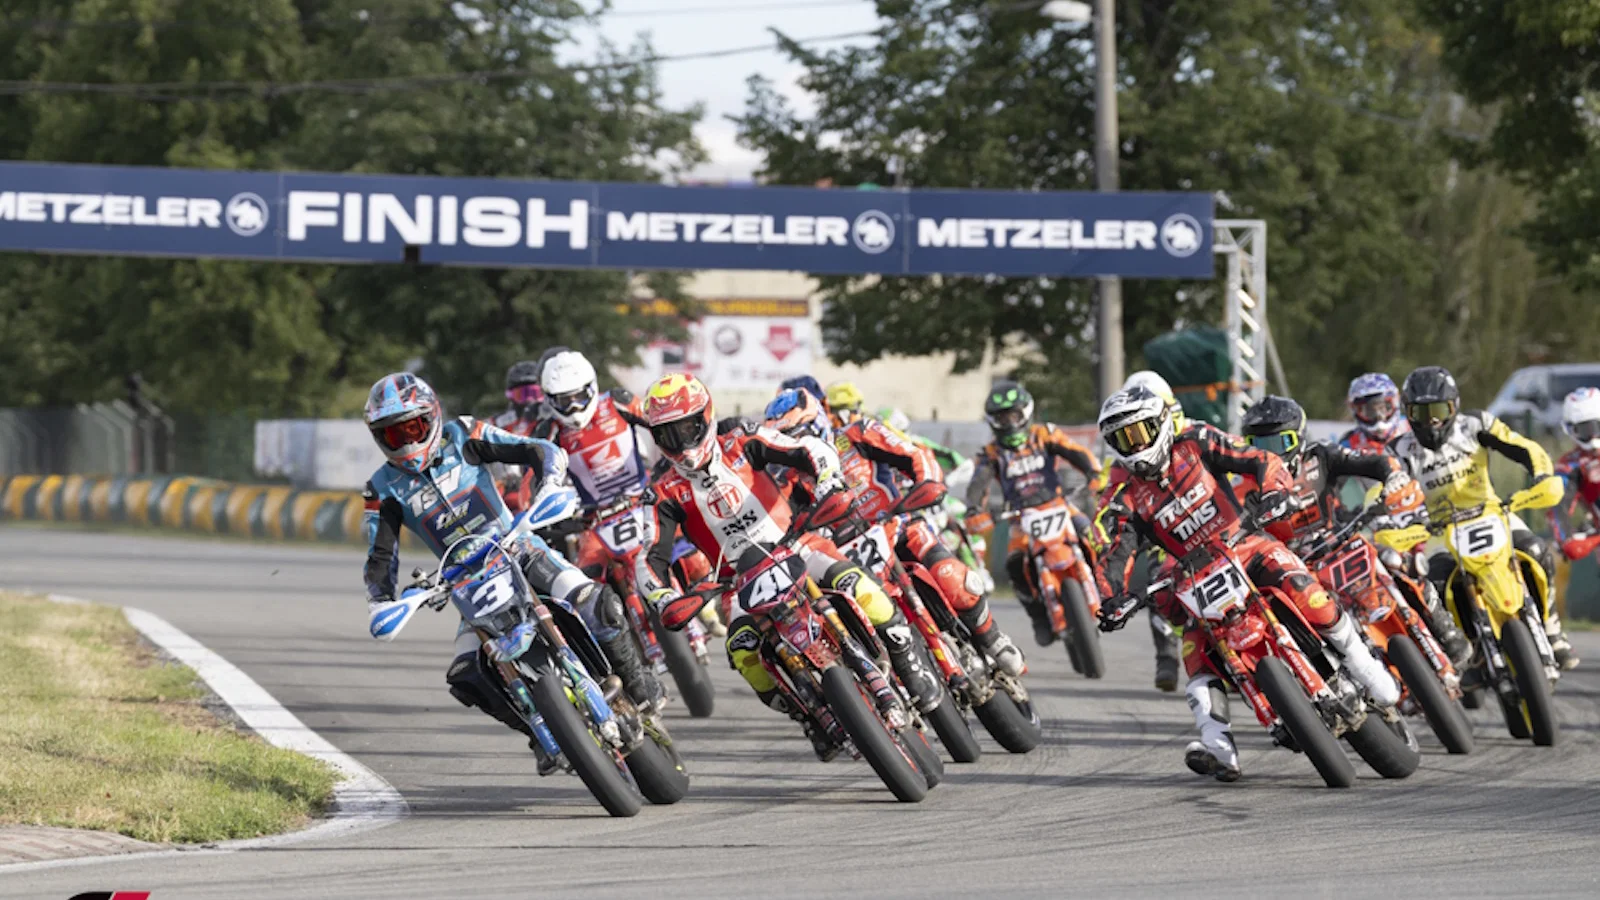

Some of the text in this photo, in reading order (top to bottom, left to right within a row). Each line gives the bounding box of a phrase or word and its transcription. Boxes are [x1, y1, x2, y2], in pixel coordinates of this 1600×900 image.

[287, 190, 589, 248] FINISH
[606, 211, 848, 245] METZELER
[918, 217, 1157, 249] METZELER
[613, 517, 637, 546] 6
[1030, 511, 1067, 540] 677
[1172, 499, 1218, 541] TMS
[1467, 524, 1494, 554] 5
[748, 560, 795, 607] 41
[1191, 565, 1242, 611] 121
[1331, 547, 1371, 591] 15
[471, 570, 515, 619] 3
